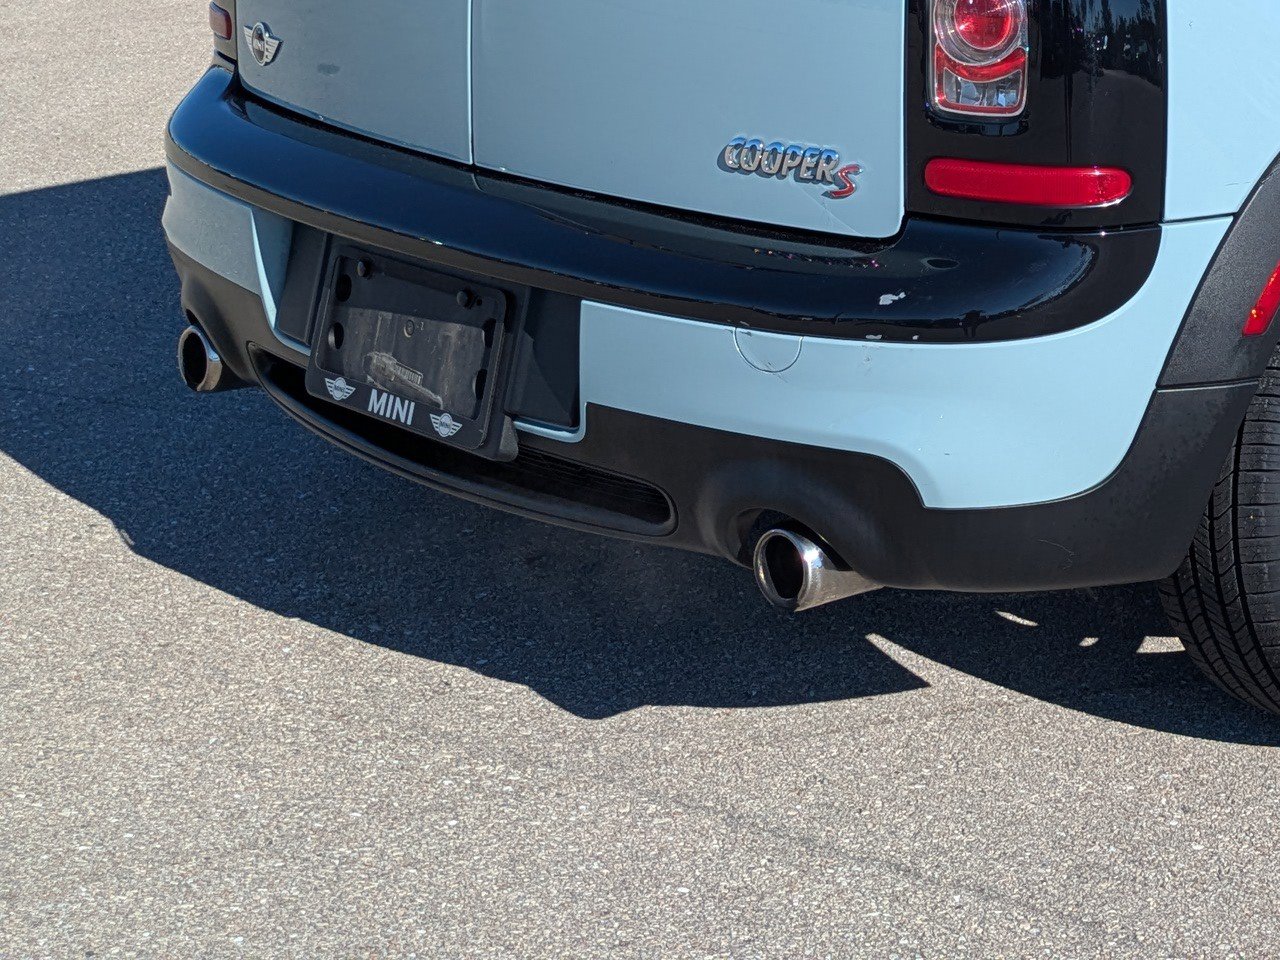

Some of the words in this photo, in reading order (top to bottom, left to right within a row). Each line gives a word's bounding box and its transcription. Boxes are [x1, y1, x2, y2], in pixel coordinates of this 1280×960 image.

[724, 136, 840, 184] COOPER
[828, 163, 863, 198] S
[367, 388, 416, 426] MINI
